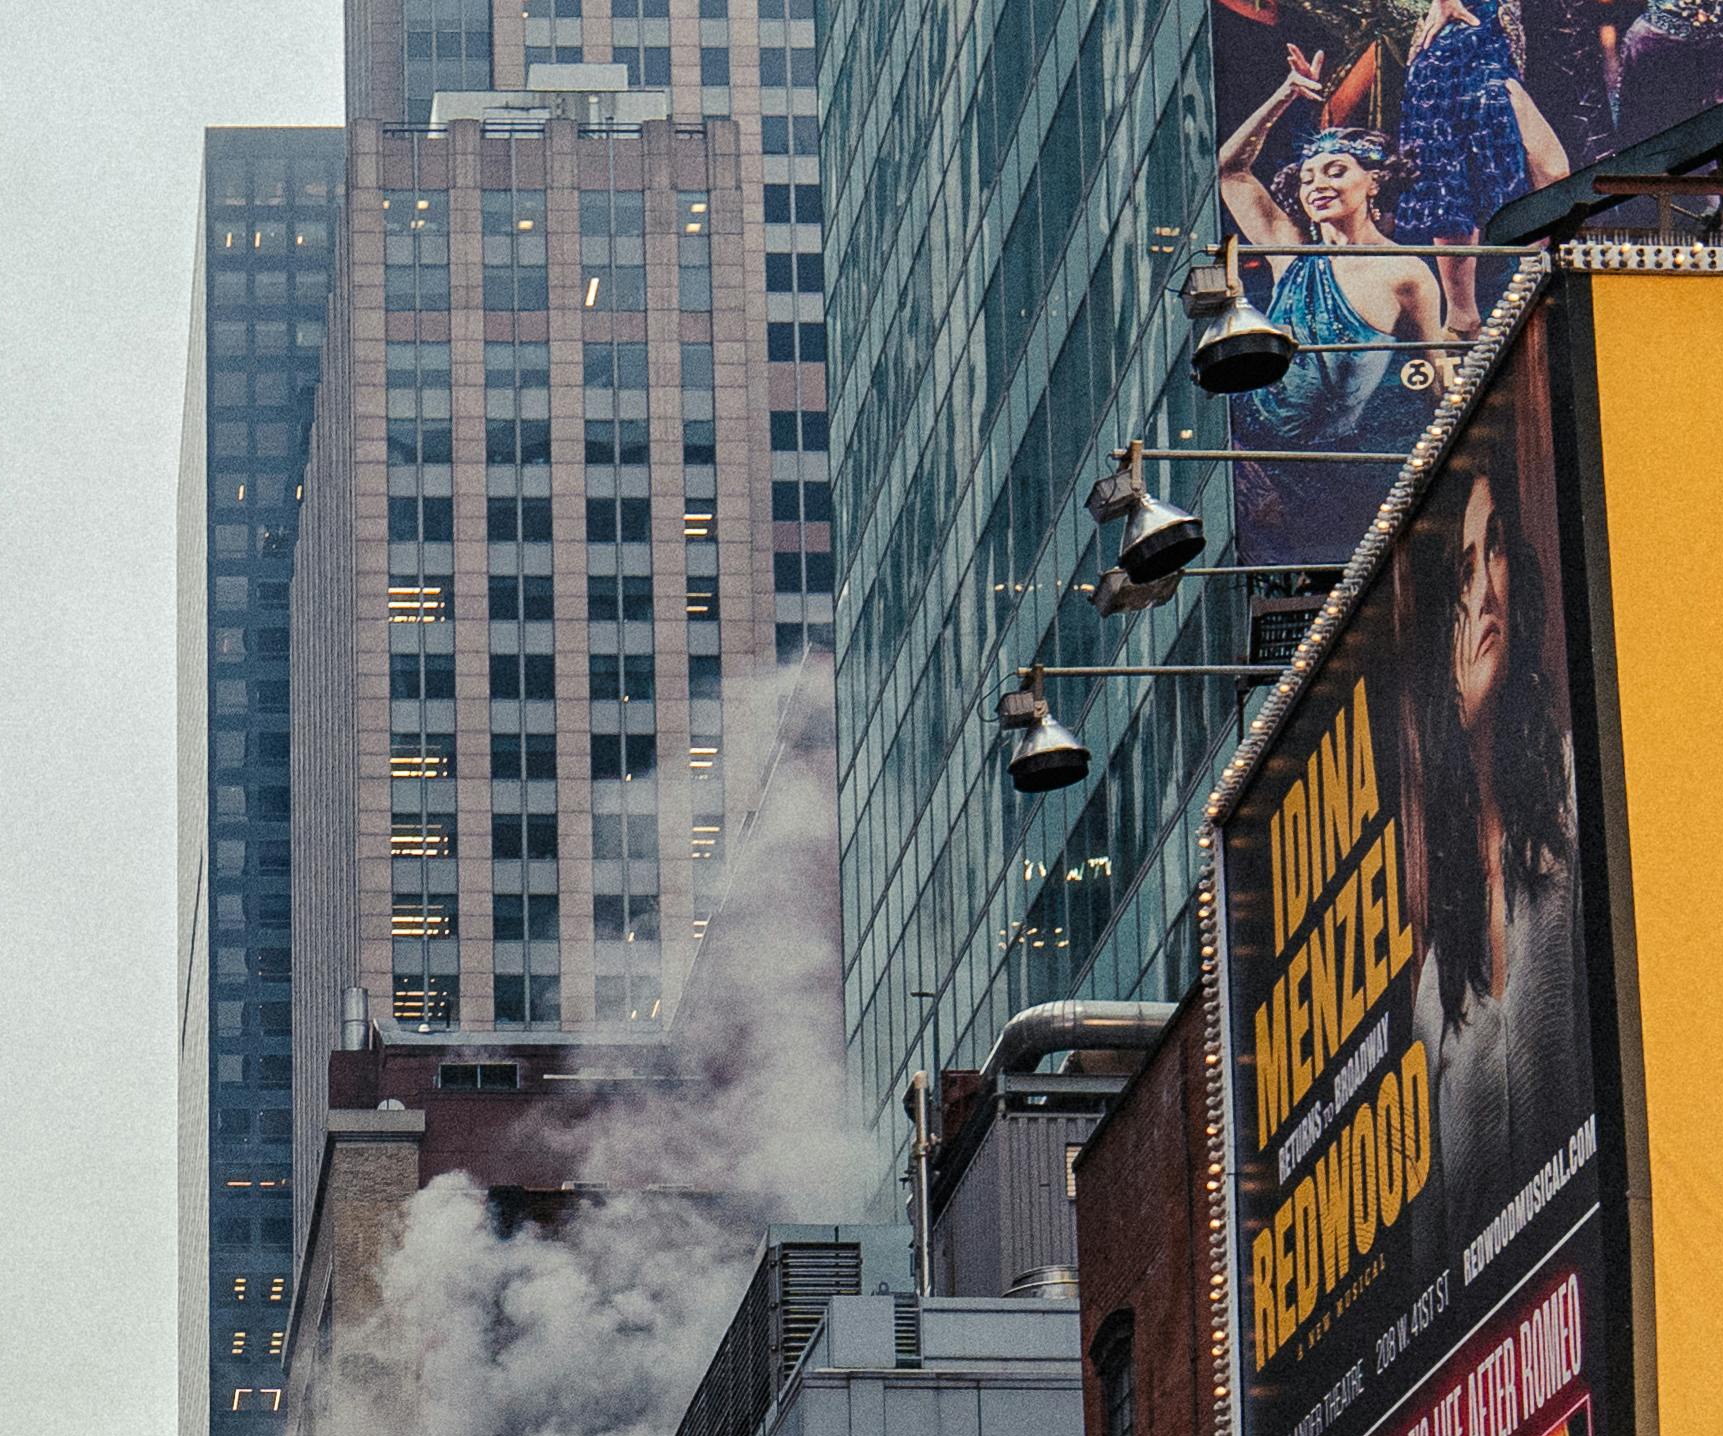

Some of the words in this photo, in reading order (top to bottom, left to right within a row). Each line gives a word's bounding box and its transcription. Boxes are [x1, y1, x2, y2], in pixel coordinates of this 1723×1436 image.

[1269, 676, 1381, 961] IDINA
[1253, 817, 1414, 1153] MENZEL
[1278, 1100, 1323, 1187] RETURNS
[1323, 1102, 1335, 1129] TO
[1334, 1011, 1390, 1115] BROADWAY
[1252, 1039, 1431, 1374] REDWOOD
[1323, 1358, 1365, 1430] THEATRE
[1376, 1326, 1397, 1376] 208
[1410, 1286, 1436, 1339] 41ST
[1436, 1269, 1451, 1314] ST
[1463, 1113, 1597, 1287] REDWOODMUSICAL.COM
[1335, 1253, 1387, 1318] MUSICAL
[1519, 1272, 1582, 1421] ROMEO
